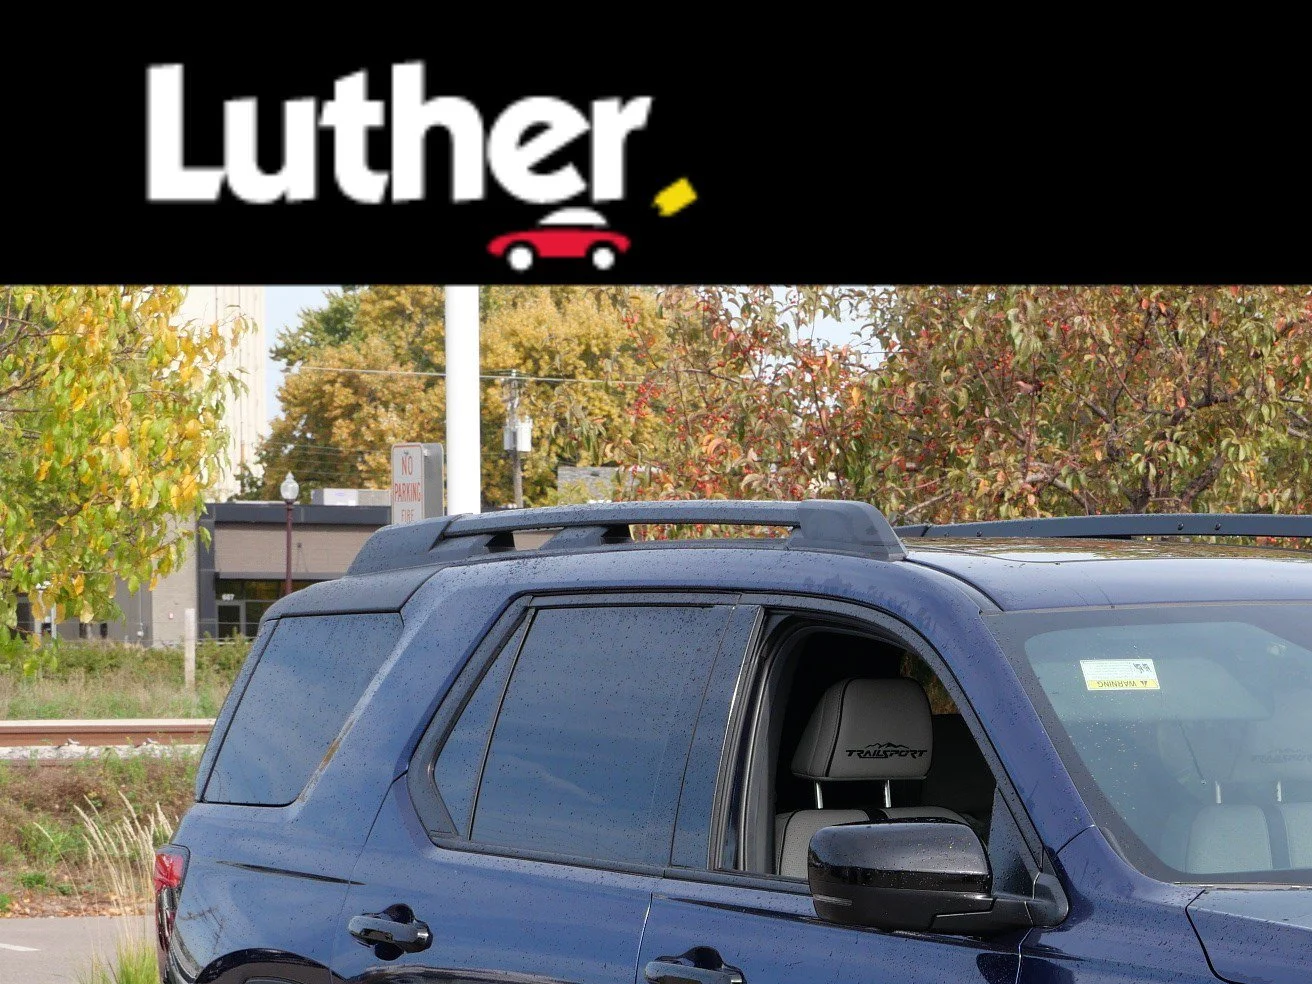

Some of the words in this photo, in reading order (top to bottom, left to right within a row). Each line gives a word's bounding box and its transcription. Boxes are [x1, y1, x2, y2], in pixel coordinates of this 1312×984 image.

[401, 455, 414, 476] NO
[394, 482, 421, 502] PARKING
[401, 508, 415, 521] FIRE
[845, 749, 928, 759] TRAILSPORT
